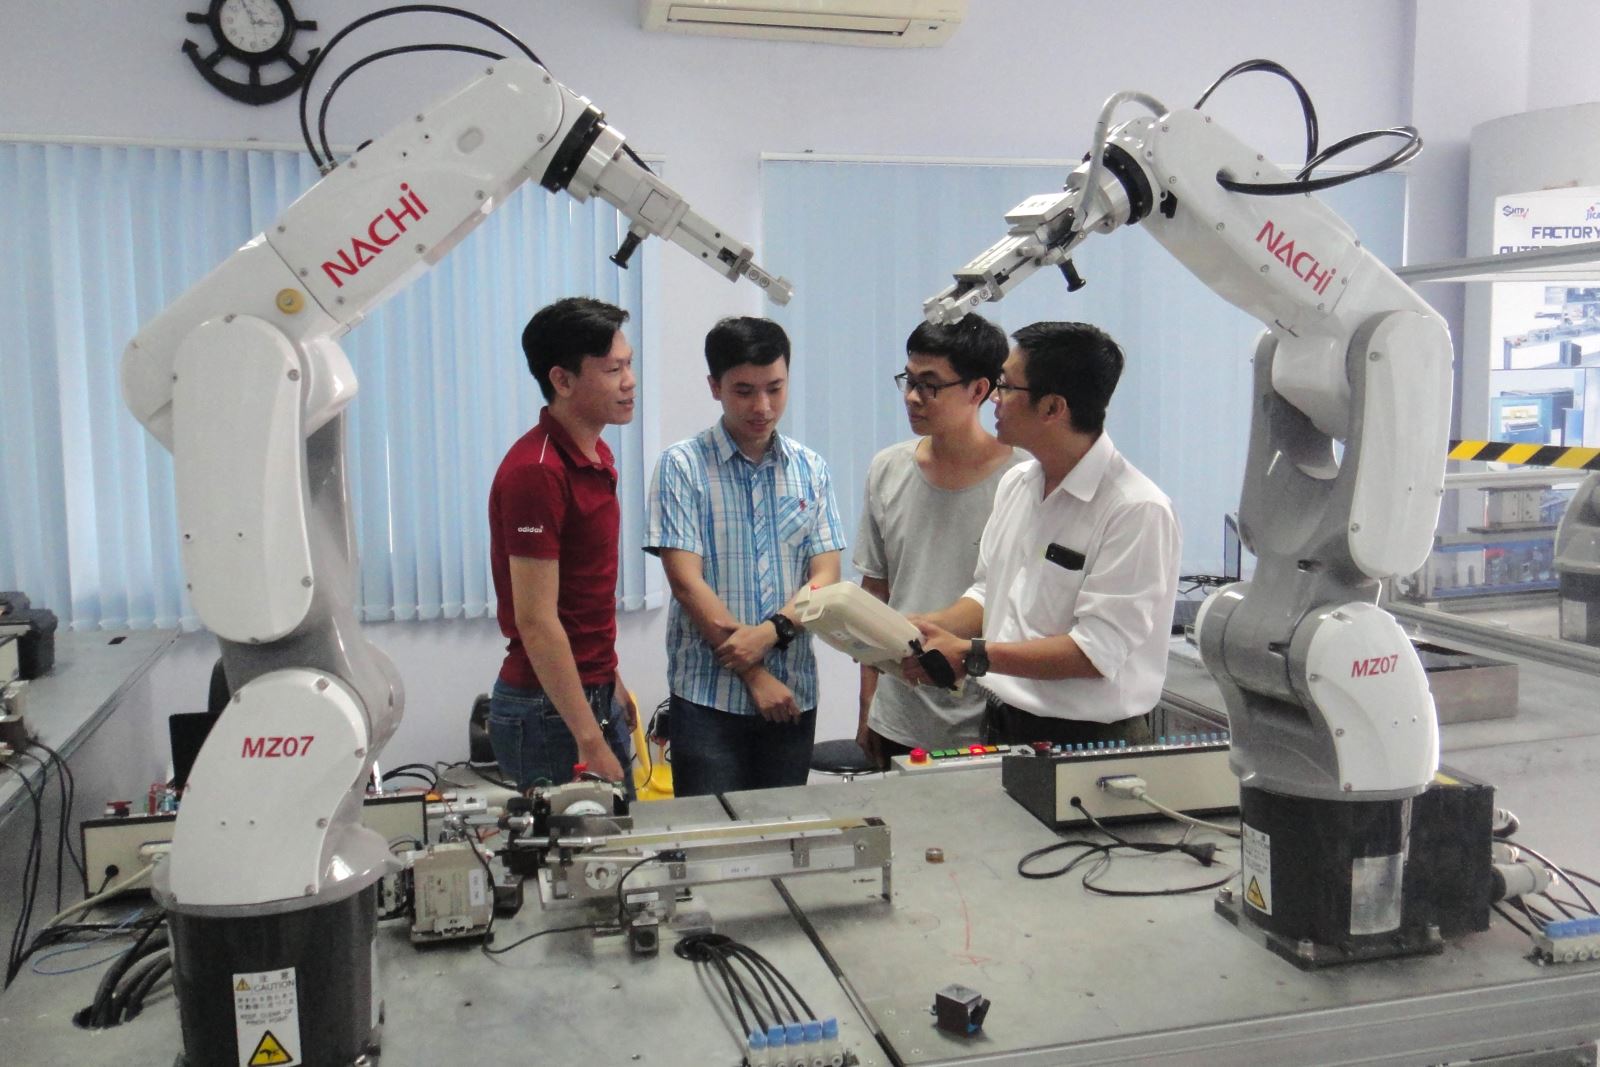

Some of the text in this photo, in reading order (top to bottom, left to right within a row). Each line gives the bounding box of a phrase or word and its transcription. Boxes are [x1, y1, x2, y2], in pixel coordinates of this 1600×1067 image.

[1531, 226, 1600, 239] FACTORY
[1351, 654, 1399, 678] MZ07
[241, 736, 315, 758] MZ07
